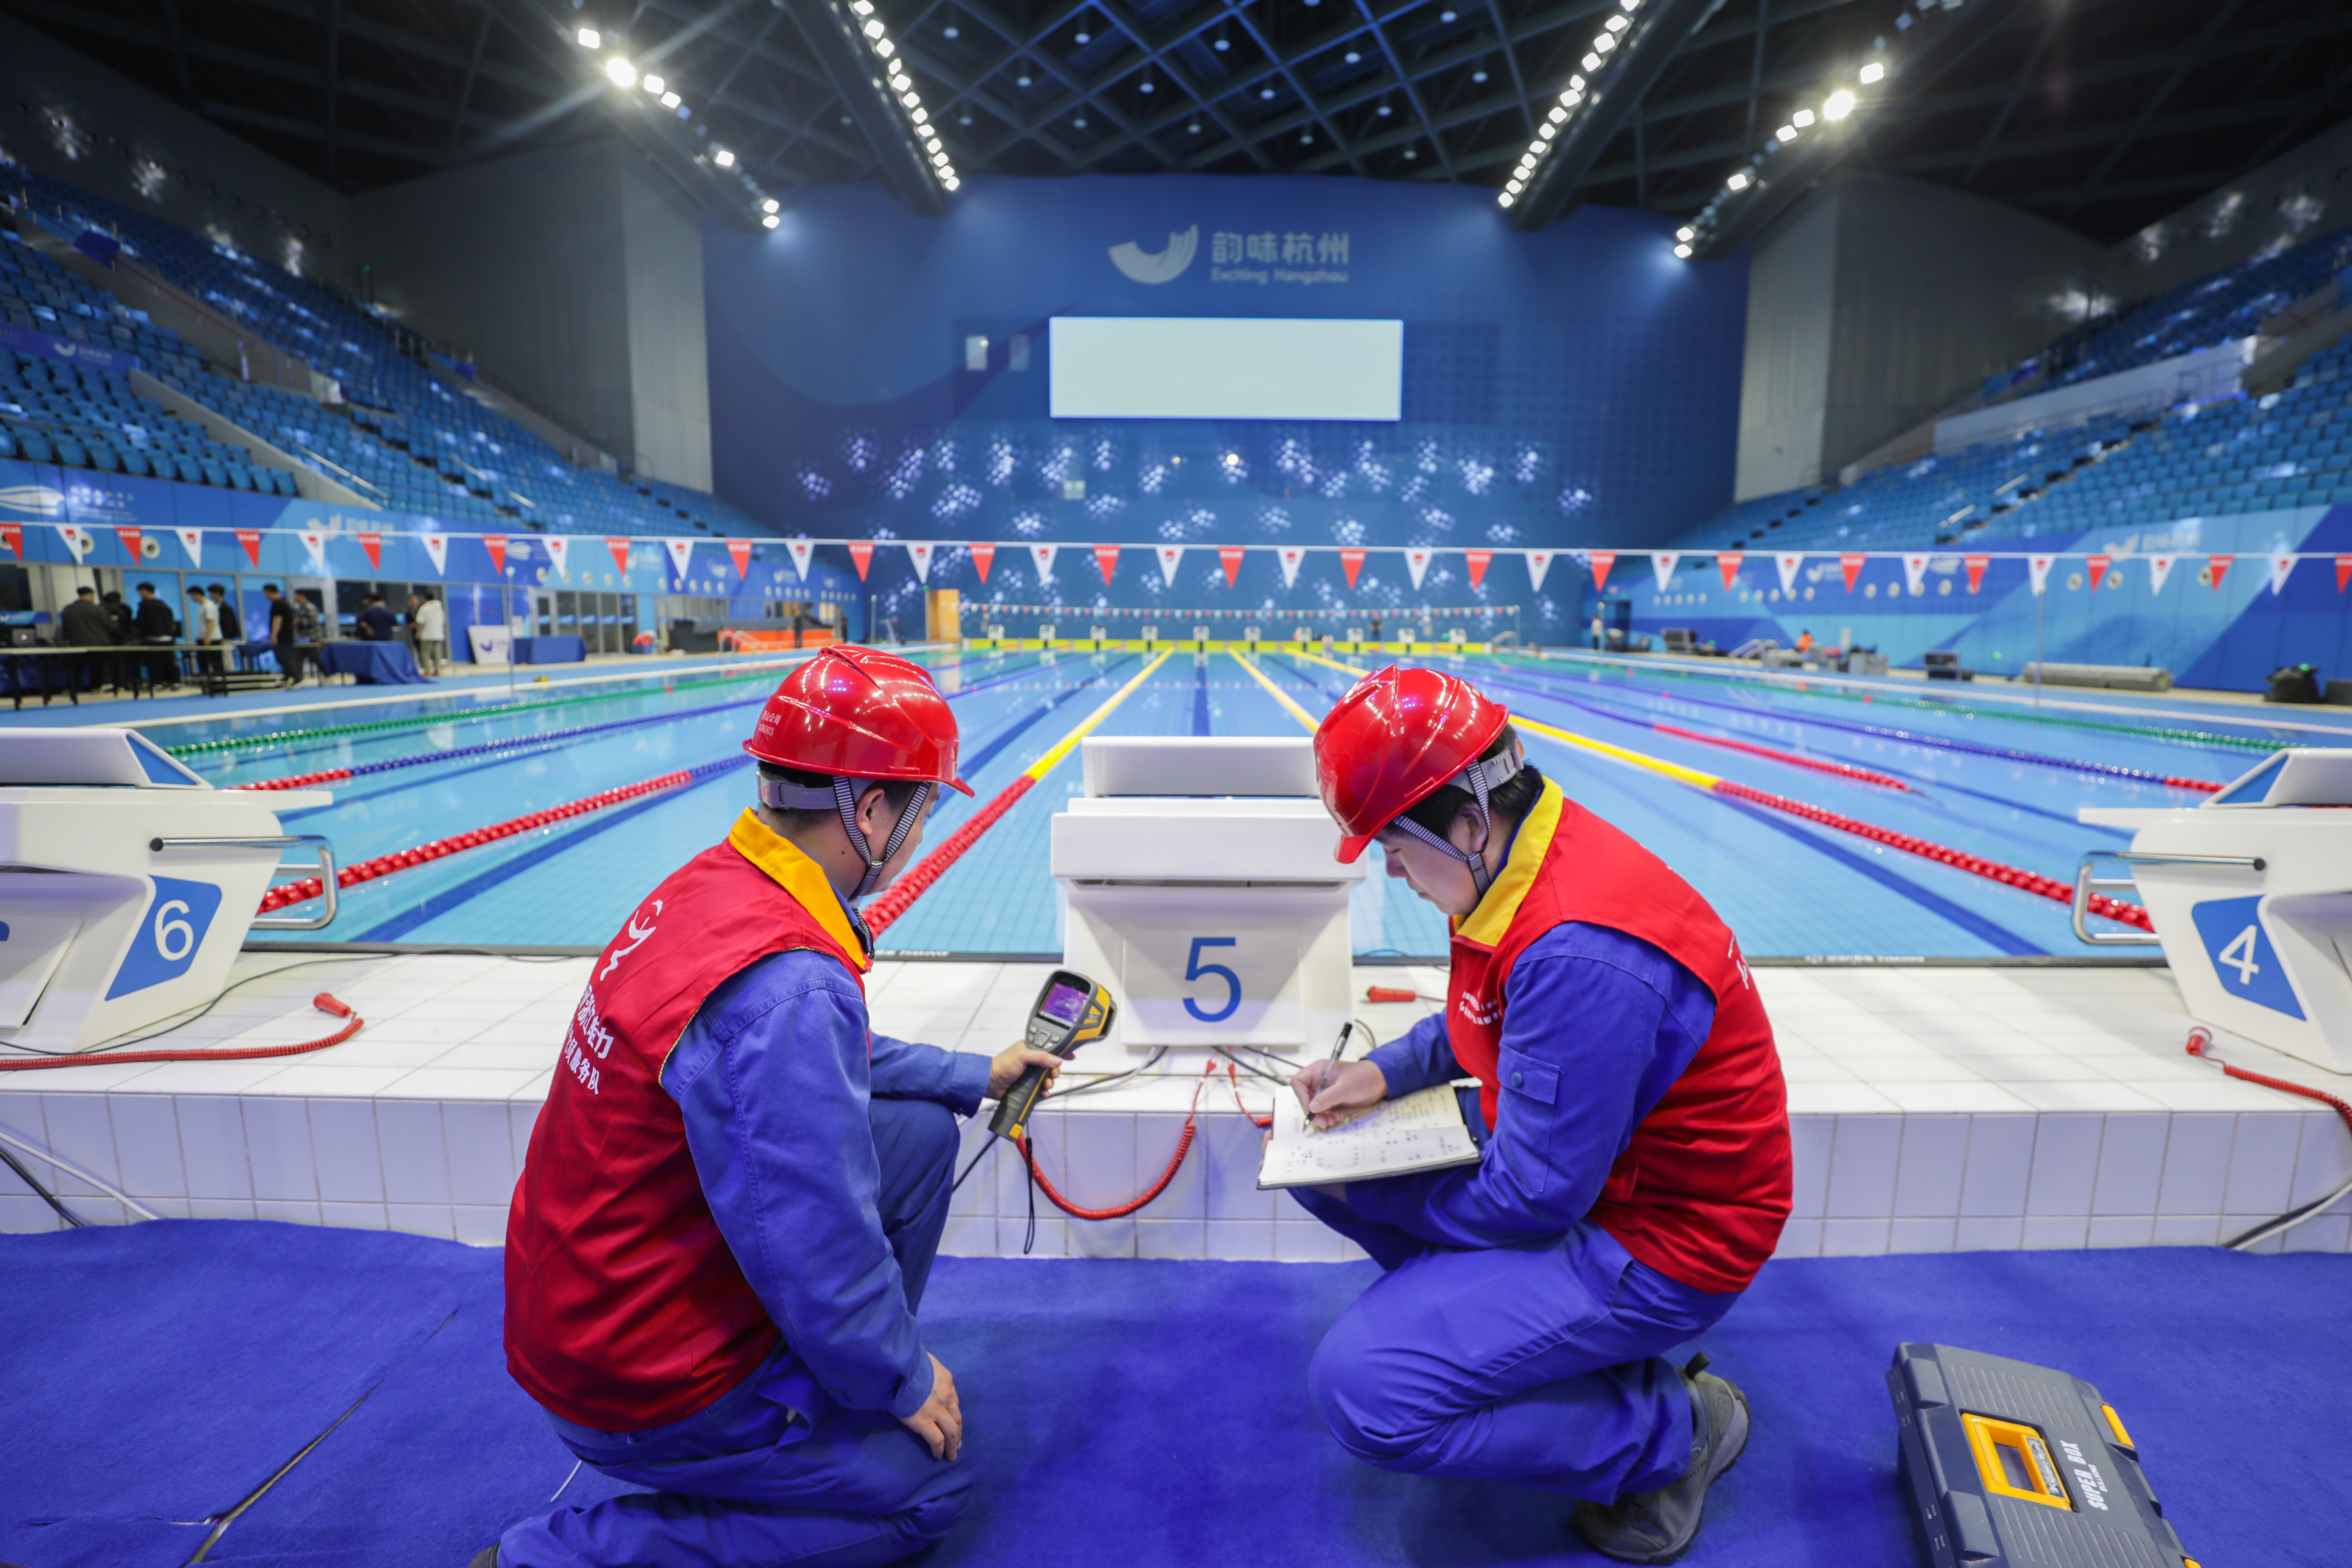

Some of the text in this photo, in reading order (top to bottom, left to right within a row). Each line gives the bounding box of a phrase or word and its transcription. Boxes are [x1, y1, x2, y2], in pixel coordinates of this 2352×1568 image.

[1211, 232, 1349, 265] 韵味杭州
[1211, 268, 1348, 285] Exciting Hangzhou
[154, 900, 194, 961] 6
[2219, 924, 2260, 985] 4
[1182, 937, 1241, 1022] 5
[578, 983, 614, 1059] 网浙江电力
[2060, 1439, 2108, 1511] SUPER BOX
[2088, 1463, 2108, 1492] BULLKING
